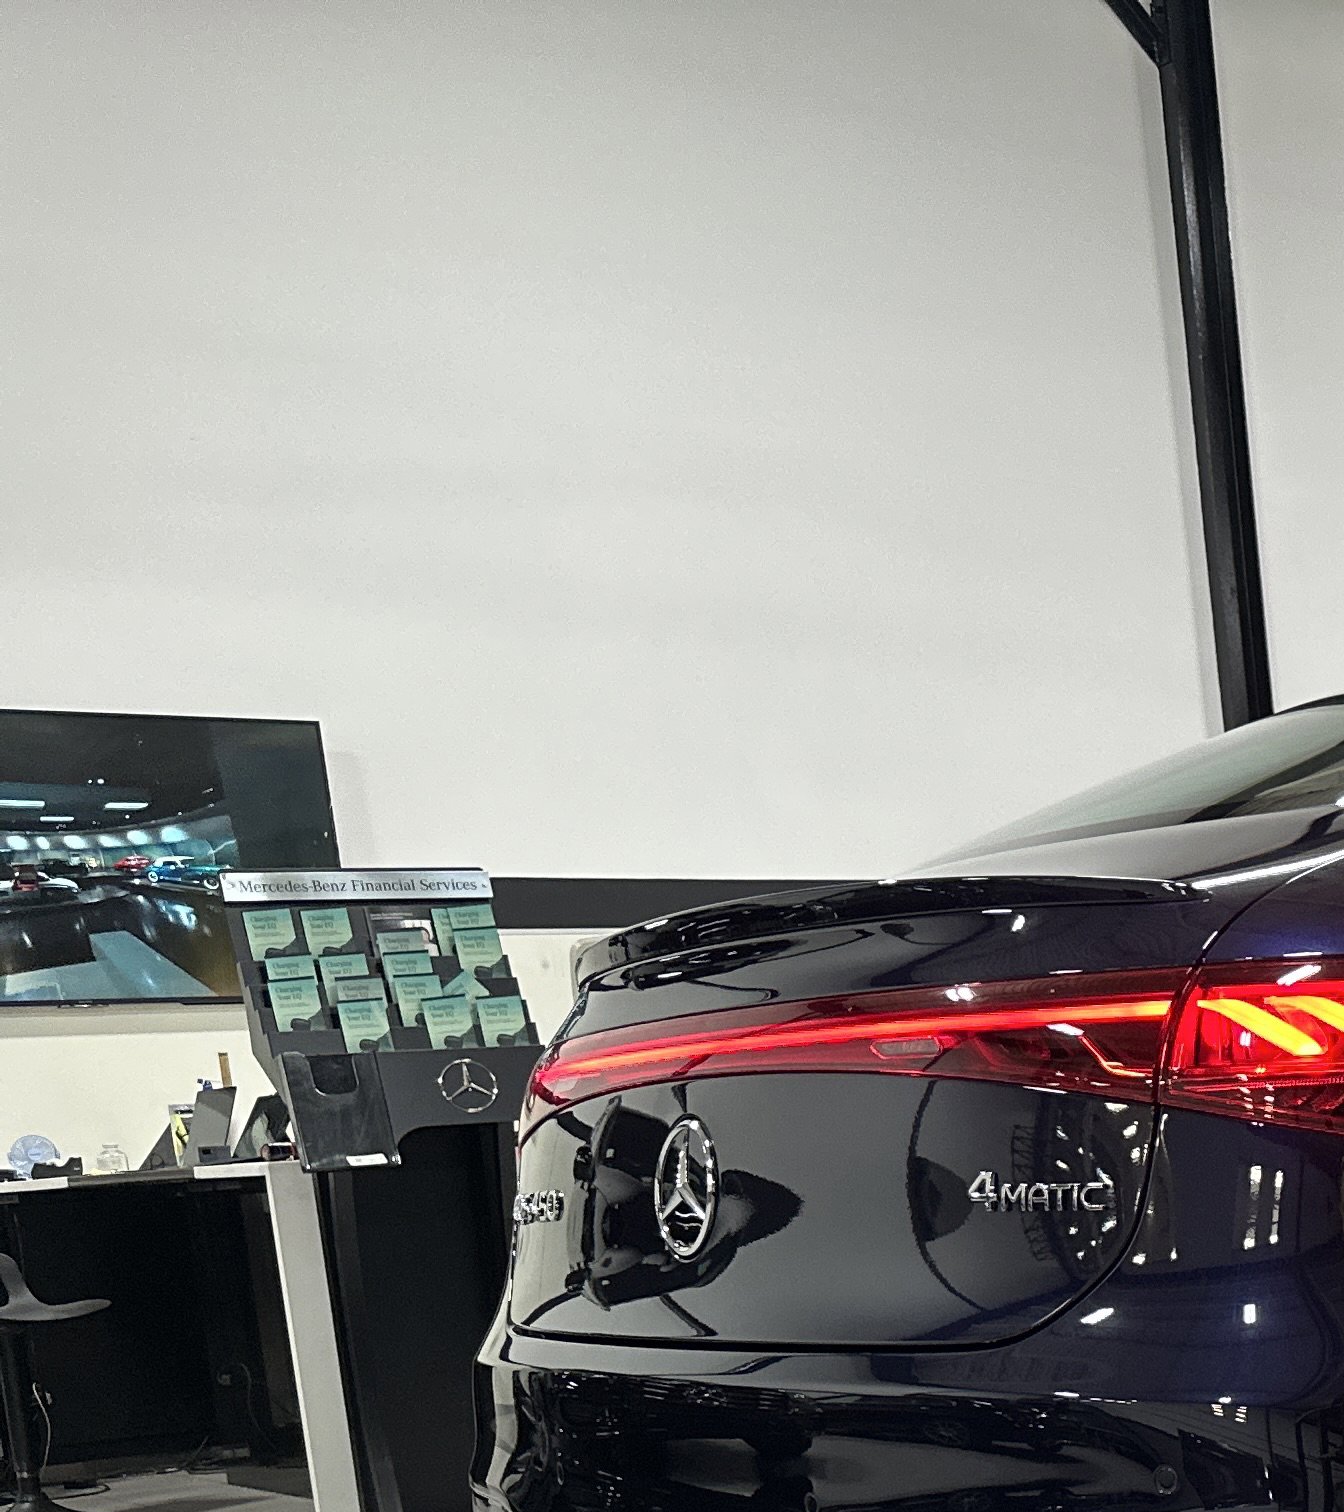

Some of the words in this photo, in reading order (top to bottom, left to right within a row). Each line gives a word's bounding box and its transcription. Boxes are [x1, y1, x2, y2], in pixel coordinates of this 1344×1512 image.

[239, 880, 347, 893] Mercedes-Benz
[351, 879, 416, 892] Financial
[420, 879, 478, 891] Services
[968, 1170, 1106, 1212] 4MATIC
